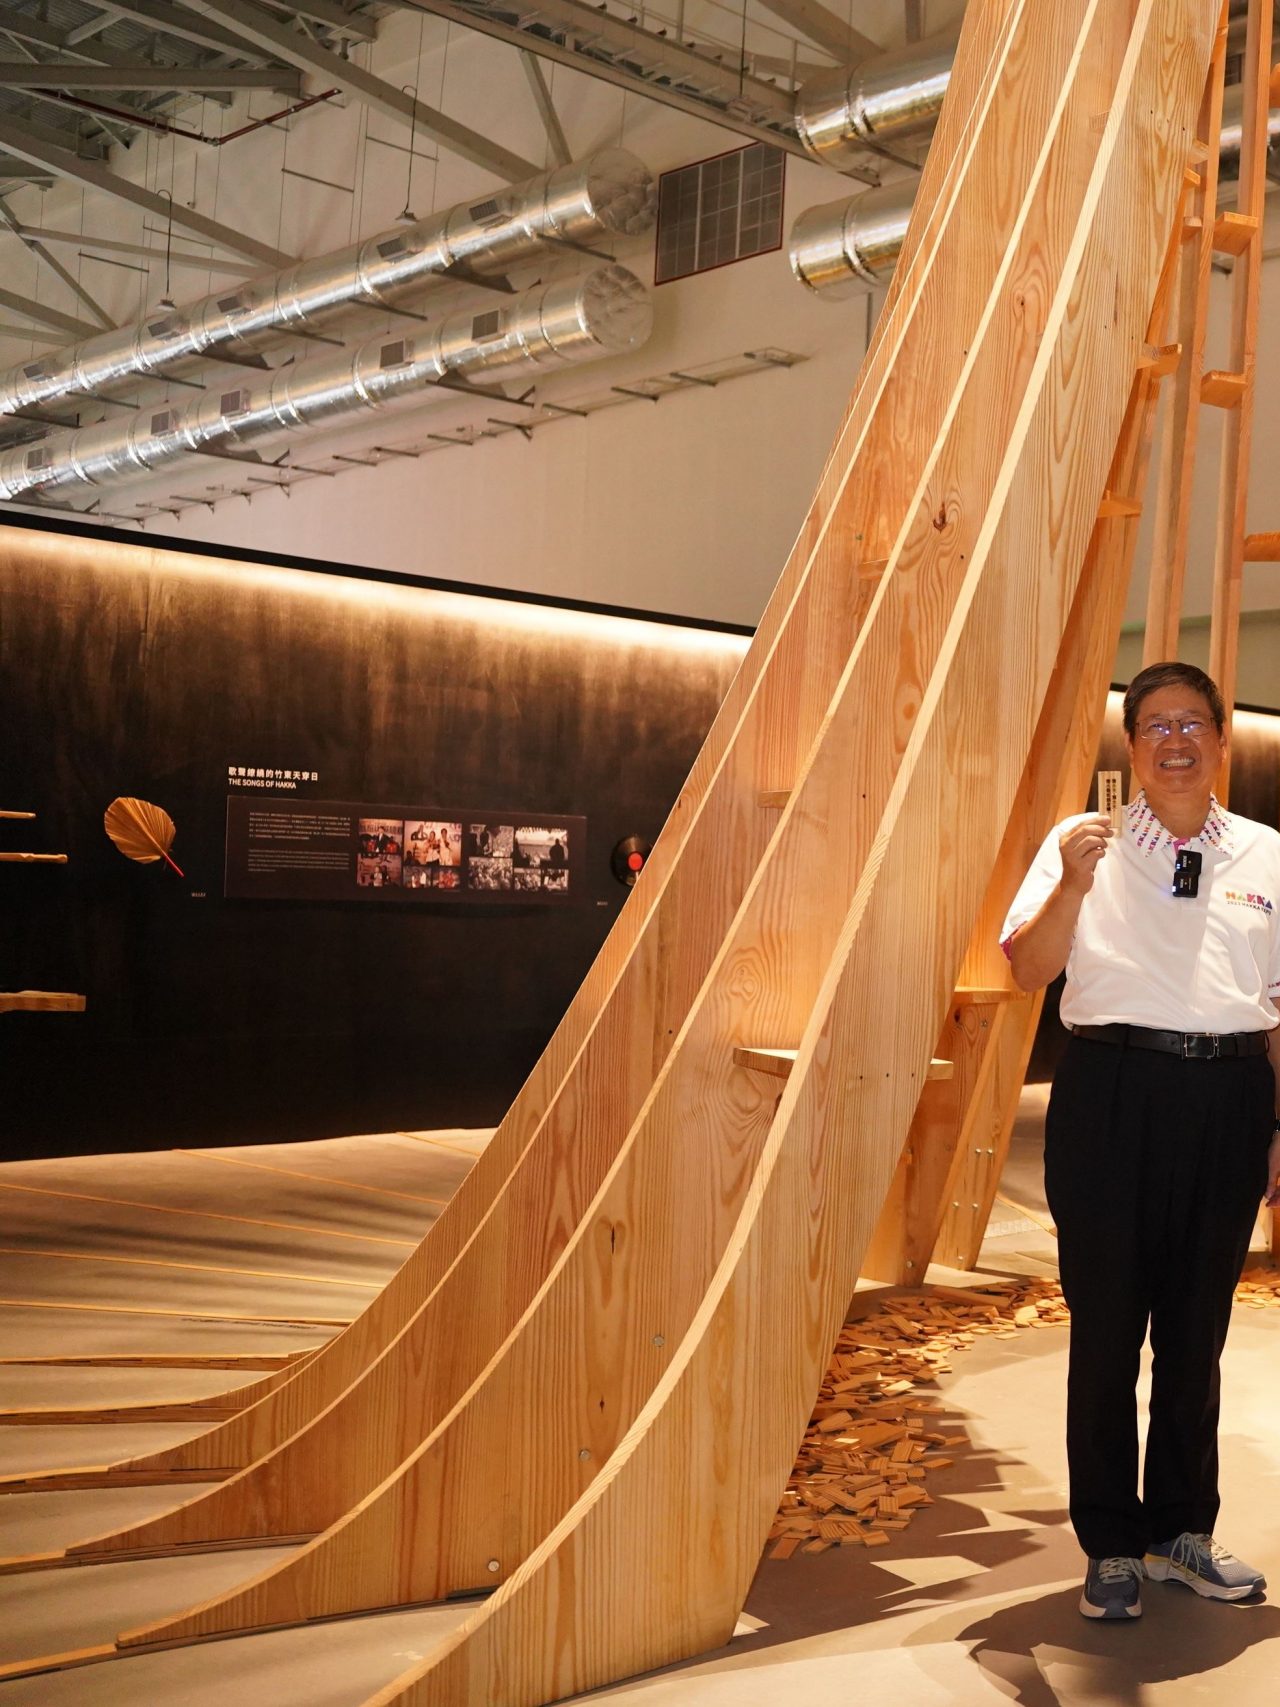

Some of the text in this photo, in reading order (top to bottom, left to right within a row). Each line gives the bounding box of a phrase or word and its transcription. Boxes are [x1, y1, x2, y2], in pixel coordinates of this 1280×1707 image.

[228, 778, 297, 789] THE SONGS OF HAKKA
[1225, 891, 1273, 910] HAKKA
